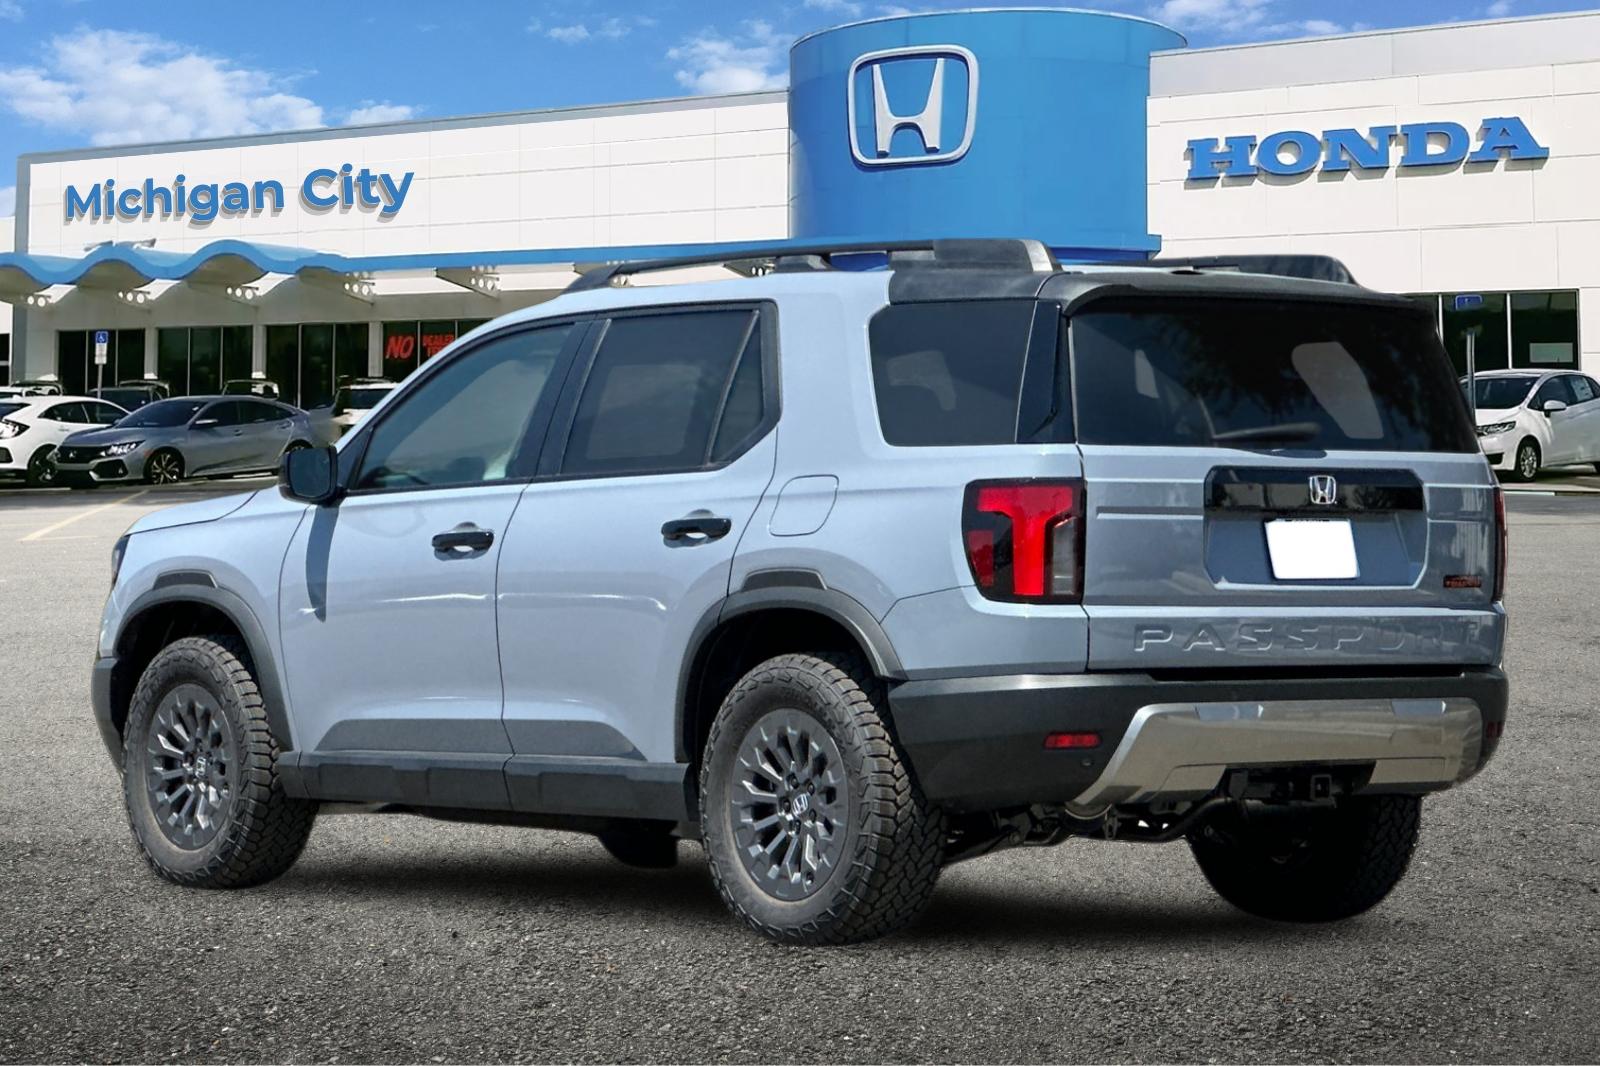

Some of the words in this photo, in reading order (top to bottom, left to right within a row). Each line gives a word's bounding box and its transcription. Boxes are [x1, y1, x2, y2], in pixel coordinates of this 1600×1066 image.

[1185, 116, 1551, 184] HONDA
[65, 173, 285, 223] Michigan
[301, 163, 415, 216] City
[385, 335, 415, 359] NO
